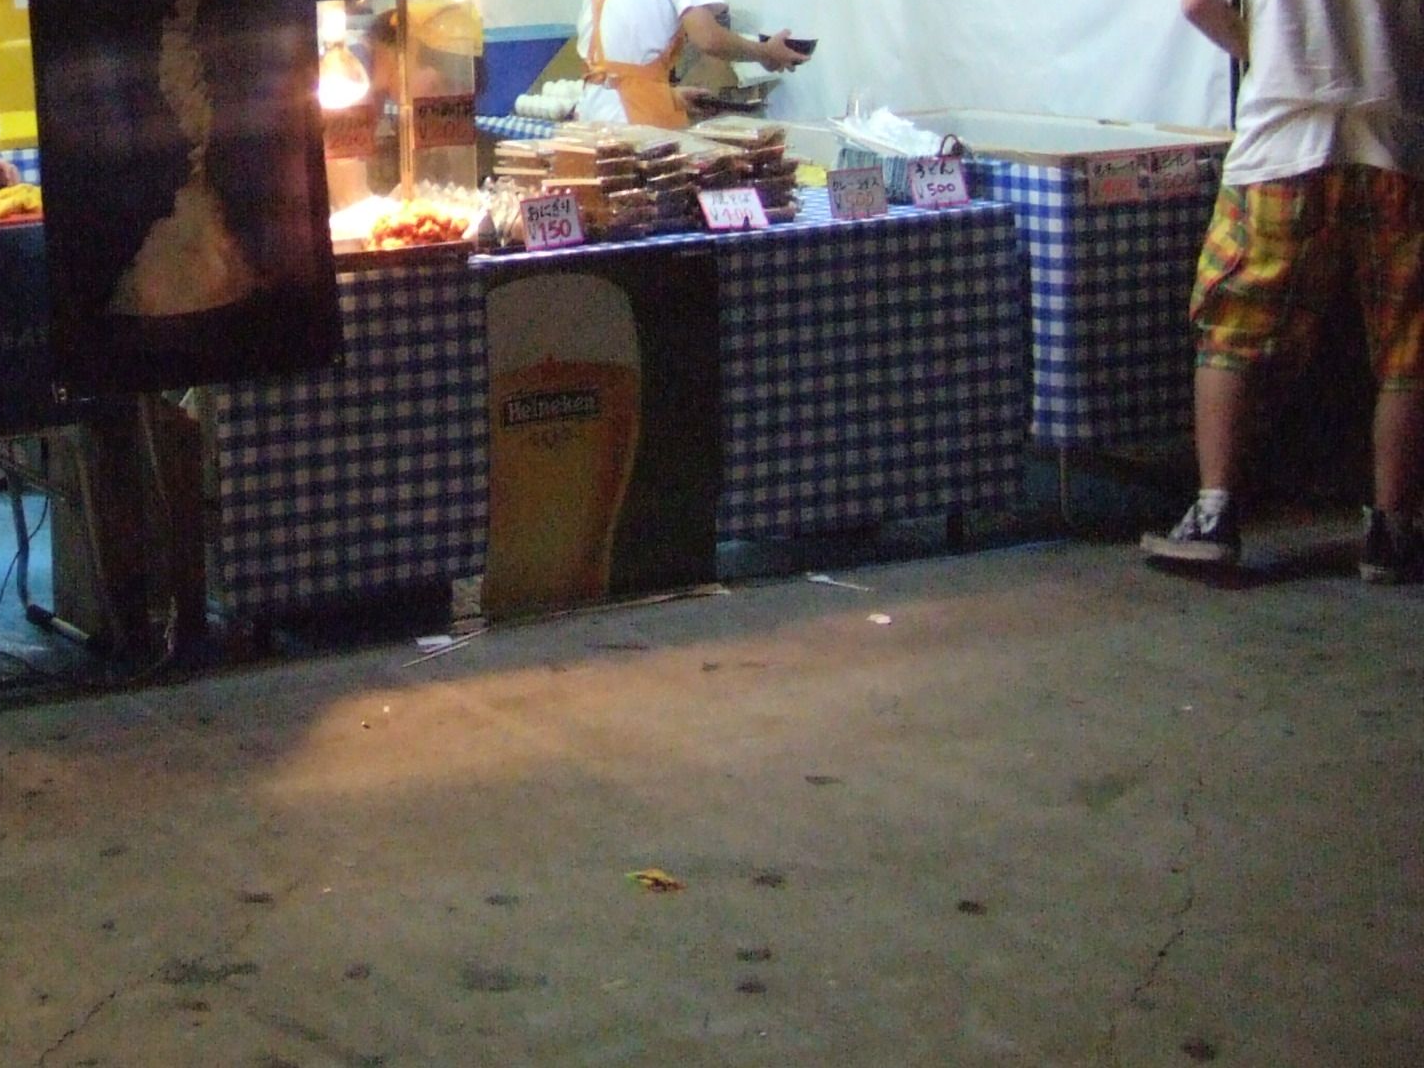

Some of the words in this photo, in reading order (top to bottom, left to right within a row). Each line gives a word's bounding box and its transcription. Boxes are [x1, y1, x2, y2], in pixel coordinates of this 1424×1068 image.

[915, 161, 955, 179] うどん
[527, 200, 572, 221] おにぎり
